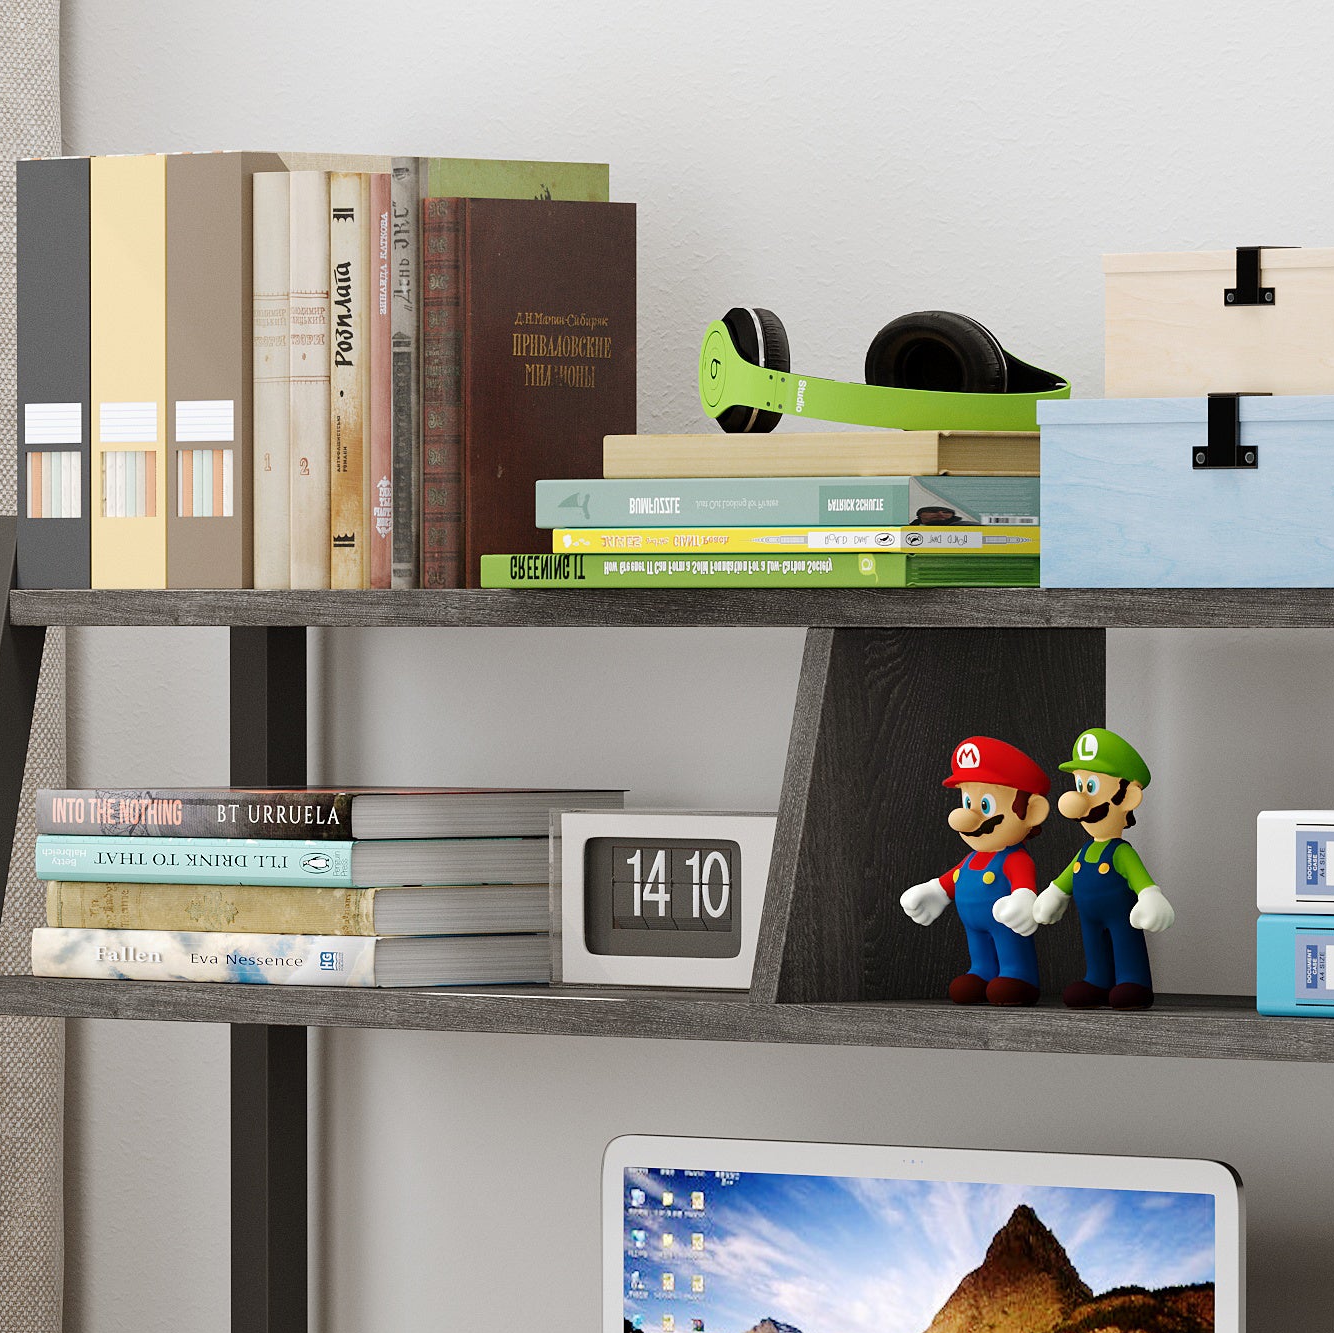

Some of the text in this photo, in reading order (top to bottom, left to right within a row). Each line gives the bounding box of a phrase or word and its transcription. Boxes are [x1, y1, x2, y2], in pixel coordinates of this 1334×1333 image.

[512, 333, 612, 359] ПРИВАЛОВСКИЕ
[796, 379, 807, 413] Studio
[264, 453, 272, 471] 1
[299, 457, 310, 475] 2
[1081, 736, 1094, 757] L
[958, 747, 978, 765] M
[52, 797, 183, 826] INTO THE NOTHING
[216, 803, 341, 825] BT URRUELA
[42, 848, 87, 858] Halbreich
[93, 851, 146, 866] THAT
[152, 852, 180, 867] TO
[186, 854, 248, 868] DRINK
[51, 857, 77, 868] Betty
[1319, 867, 1325, 878] A4
[626, 849, 730, 918] 14 10
[95, 947, 163, 963] Fallen
[190, 953, 304, 967] Eva Nessence
[1319, 971, 1325, 982] A4
